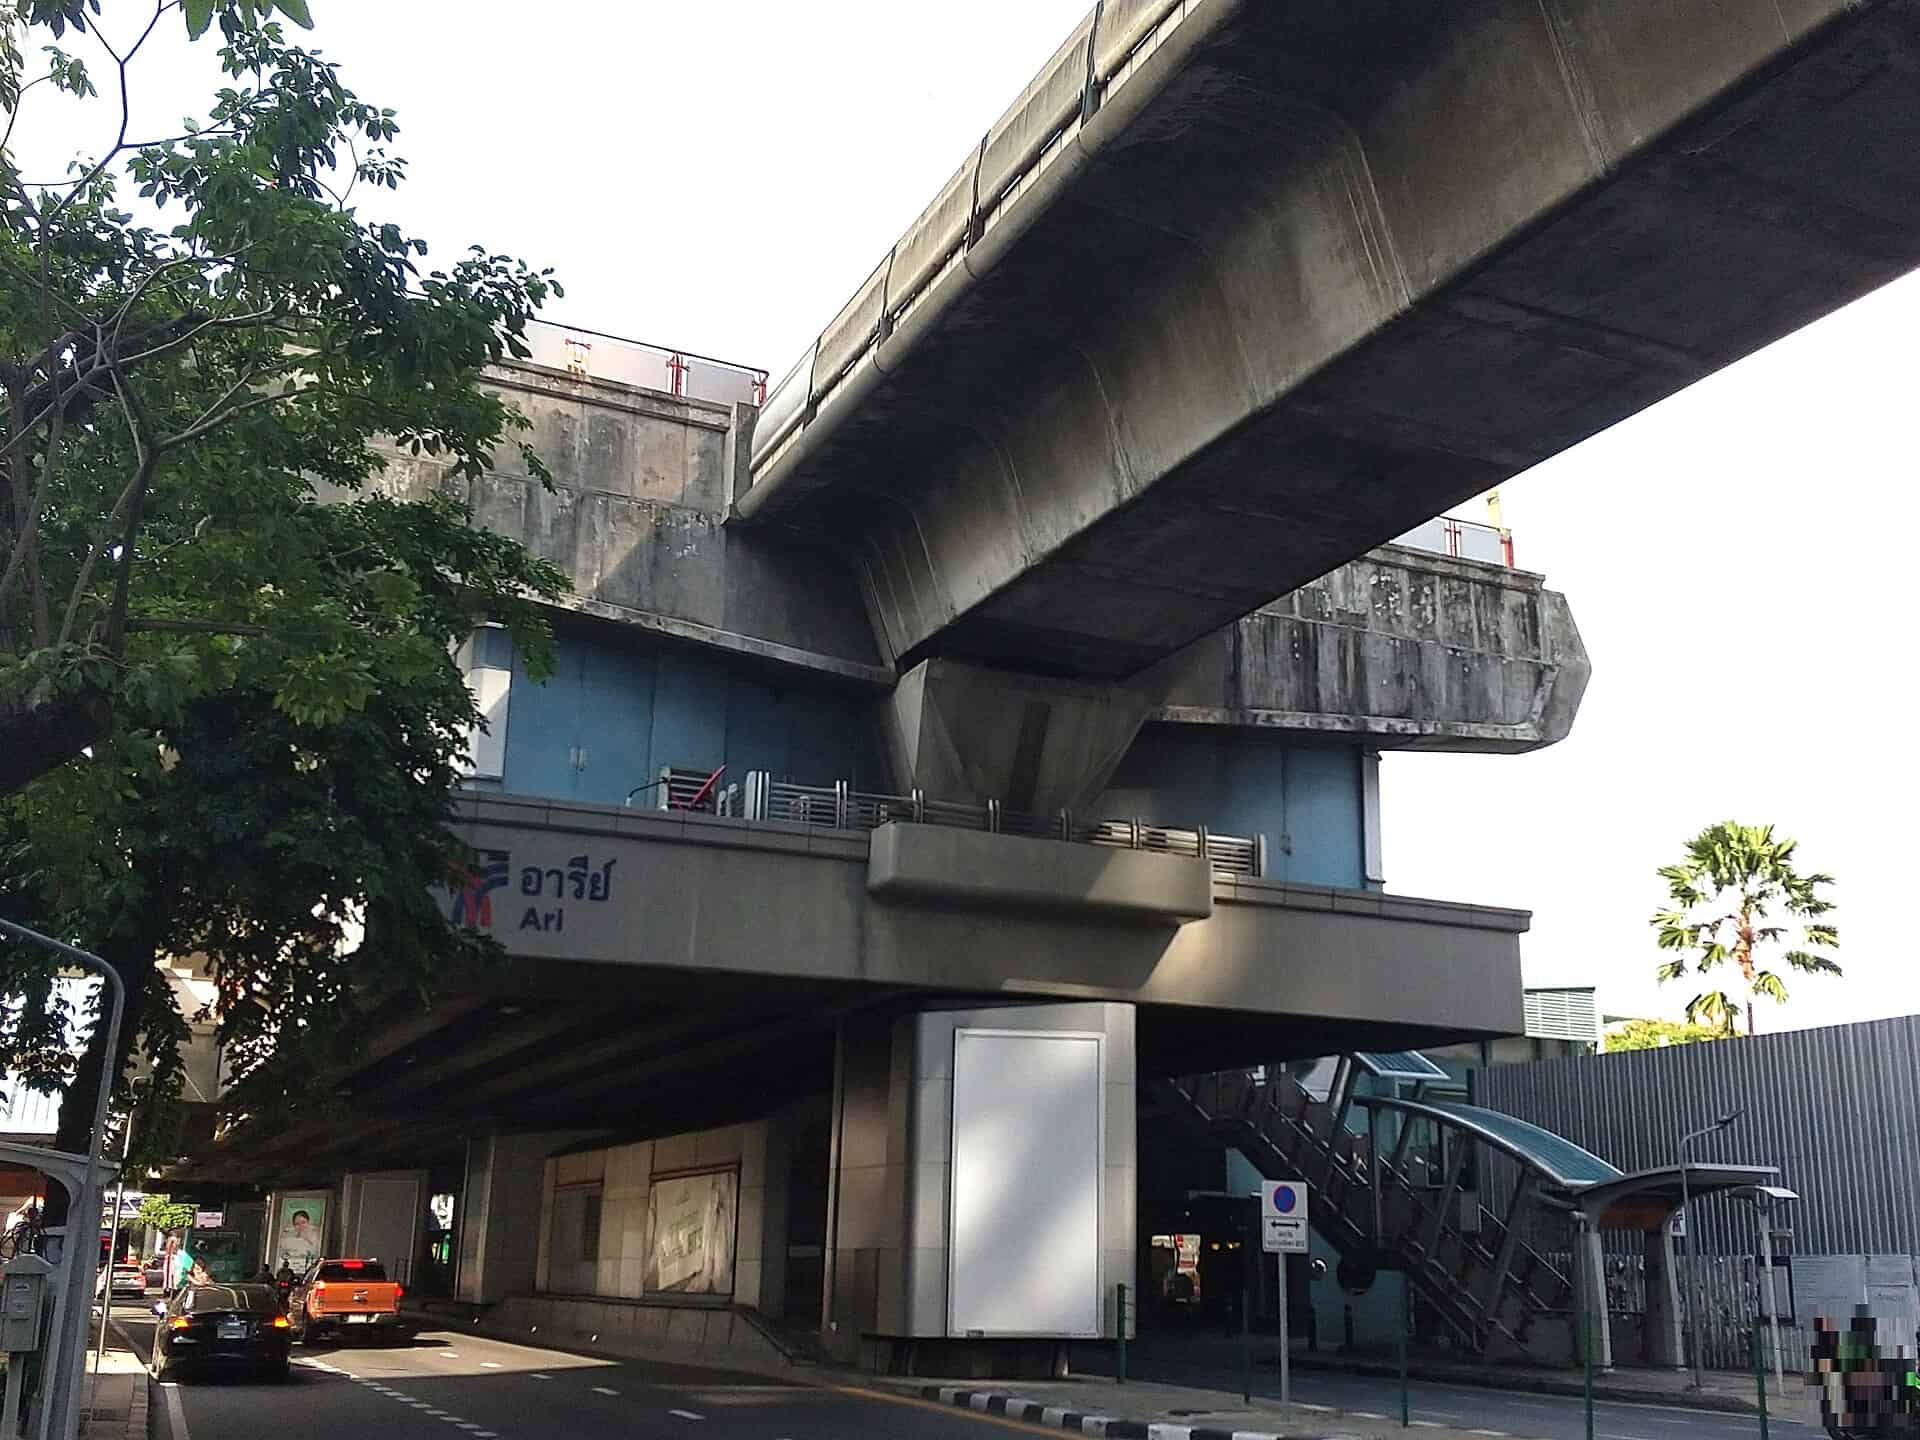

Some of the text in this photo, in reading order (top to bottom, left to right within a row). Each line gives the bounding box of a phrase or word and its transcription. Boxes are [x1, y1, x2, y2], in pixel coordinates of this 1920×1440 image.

[521, 855, 617, 901] อารีย์
[520, 907, 563, 931] Ari
